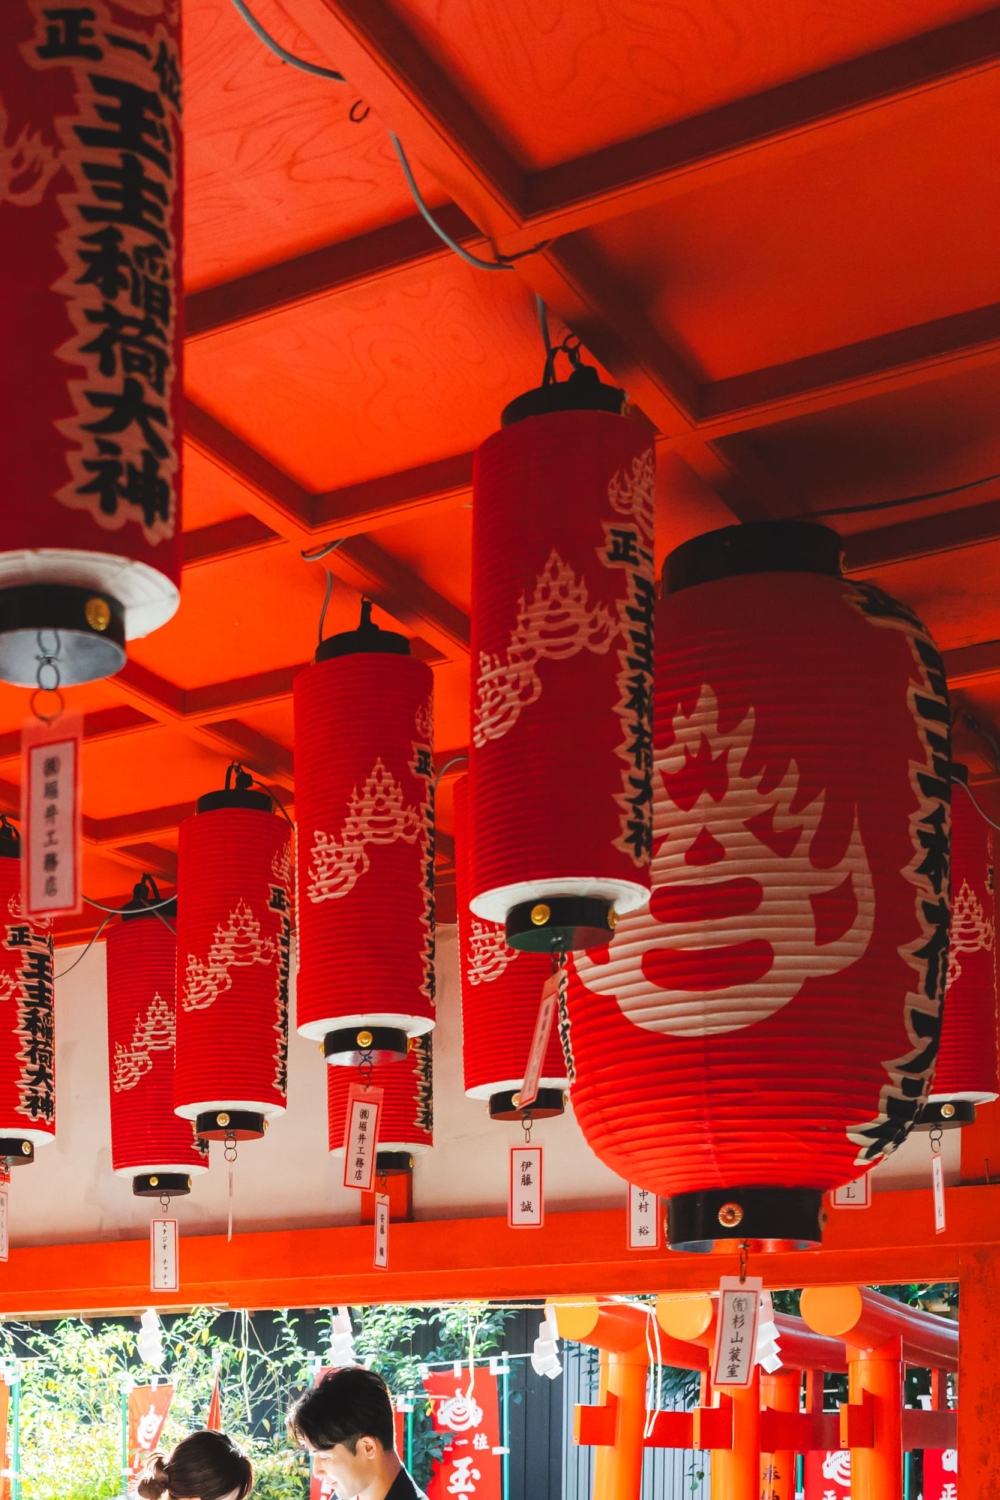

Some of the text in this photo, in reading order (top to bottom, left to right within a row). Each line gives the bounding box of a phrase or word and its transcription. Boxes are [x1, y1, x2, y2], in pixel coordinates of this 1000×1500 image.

[73, 73, 178, 528] 玉主稲荷大神
[354, 1109, 369, 1181] ㈱堀井工務店
[520, 1160, 533, 1214] 伊藤 誠
[637, 1190, 650, 1213] 中村
